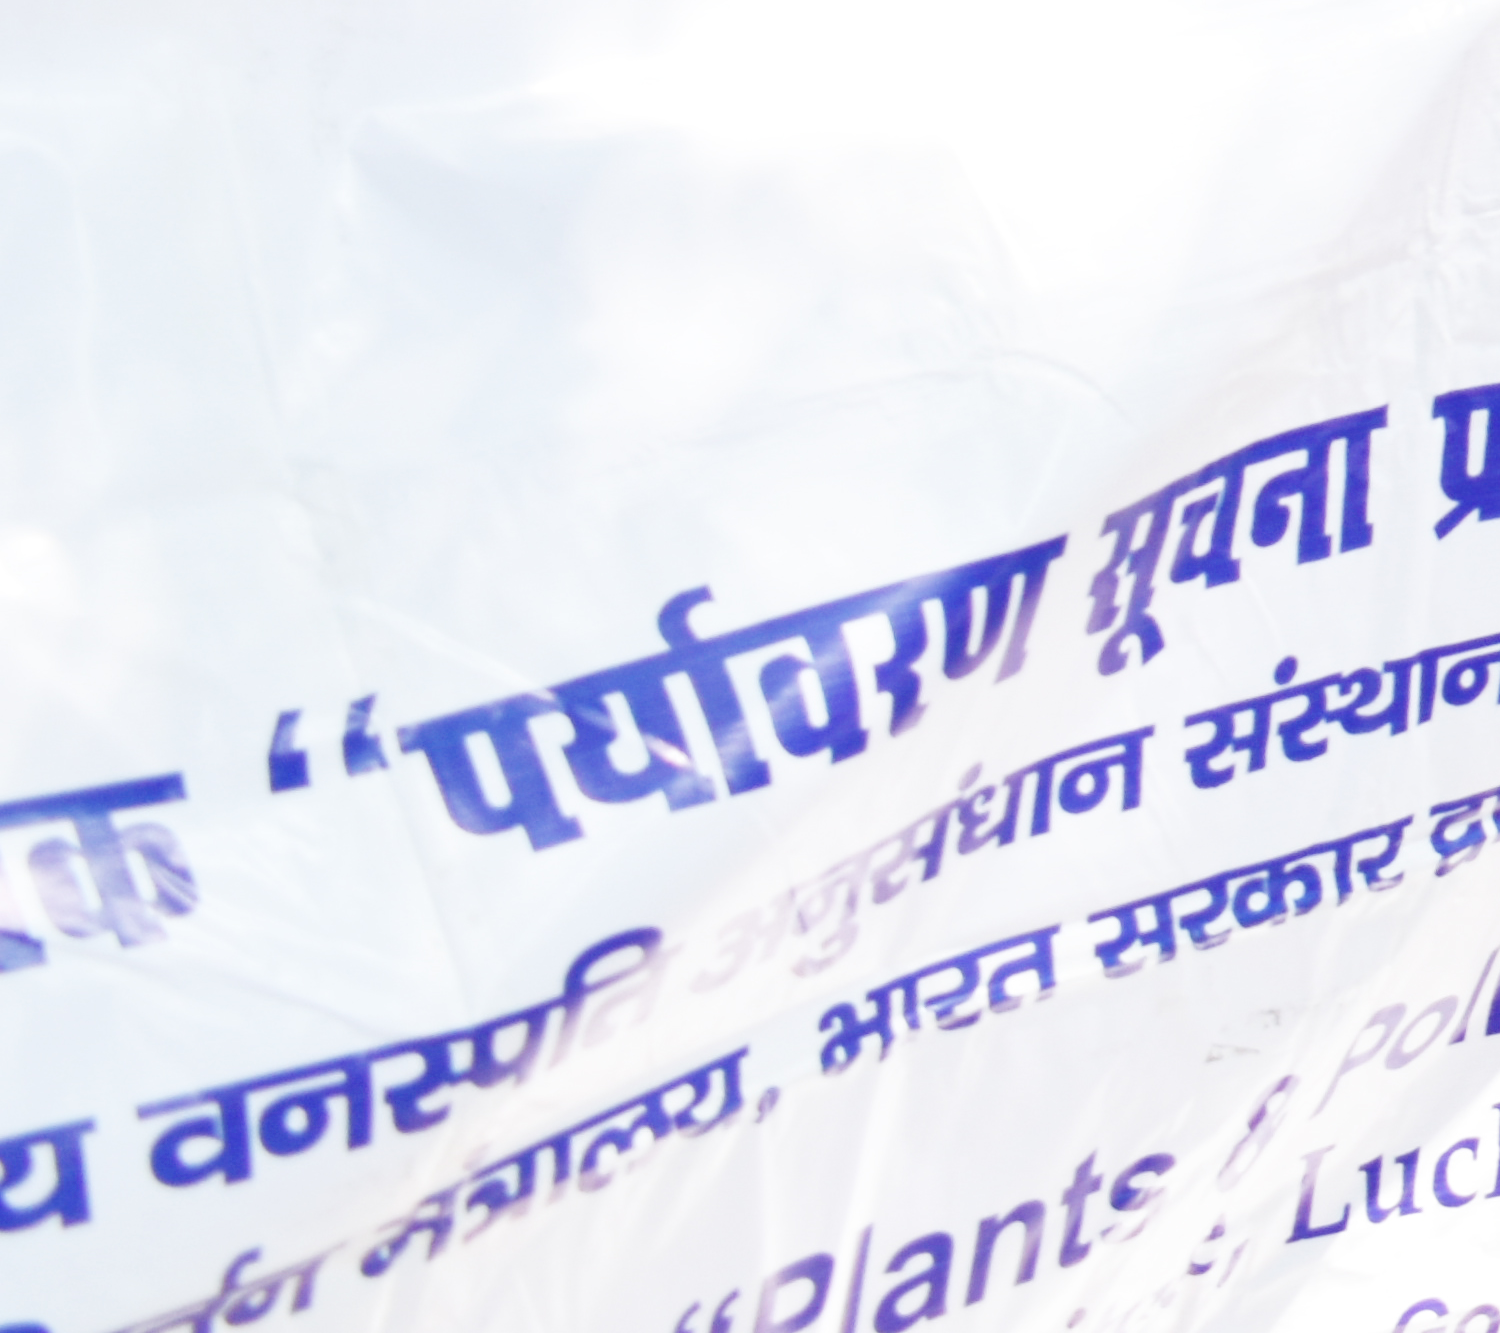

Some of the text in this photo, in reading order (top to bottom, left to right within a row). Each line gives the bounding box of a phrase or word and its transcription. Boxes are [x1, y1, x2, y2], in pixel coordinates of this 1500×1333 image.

[1086, 404, 1390, 676] सूचना
[137, 926, 675, 1189] वनस्पति
[819, 923, 1062, 1076] भारत
[1087, 814, 1413, 978] सरकार
